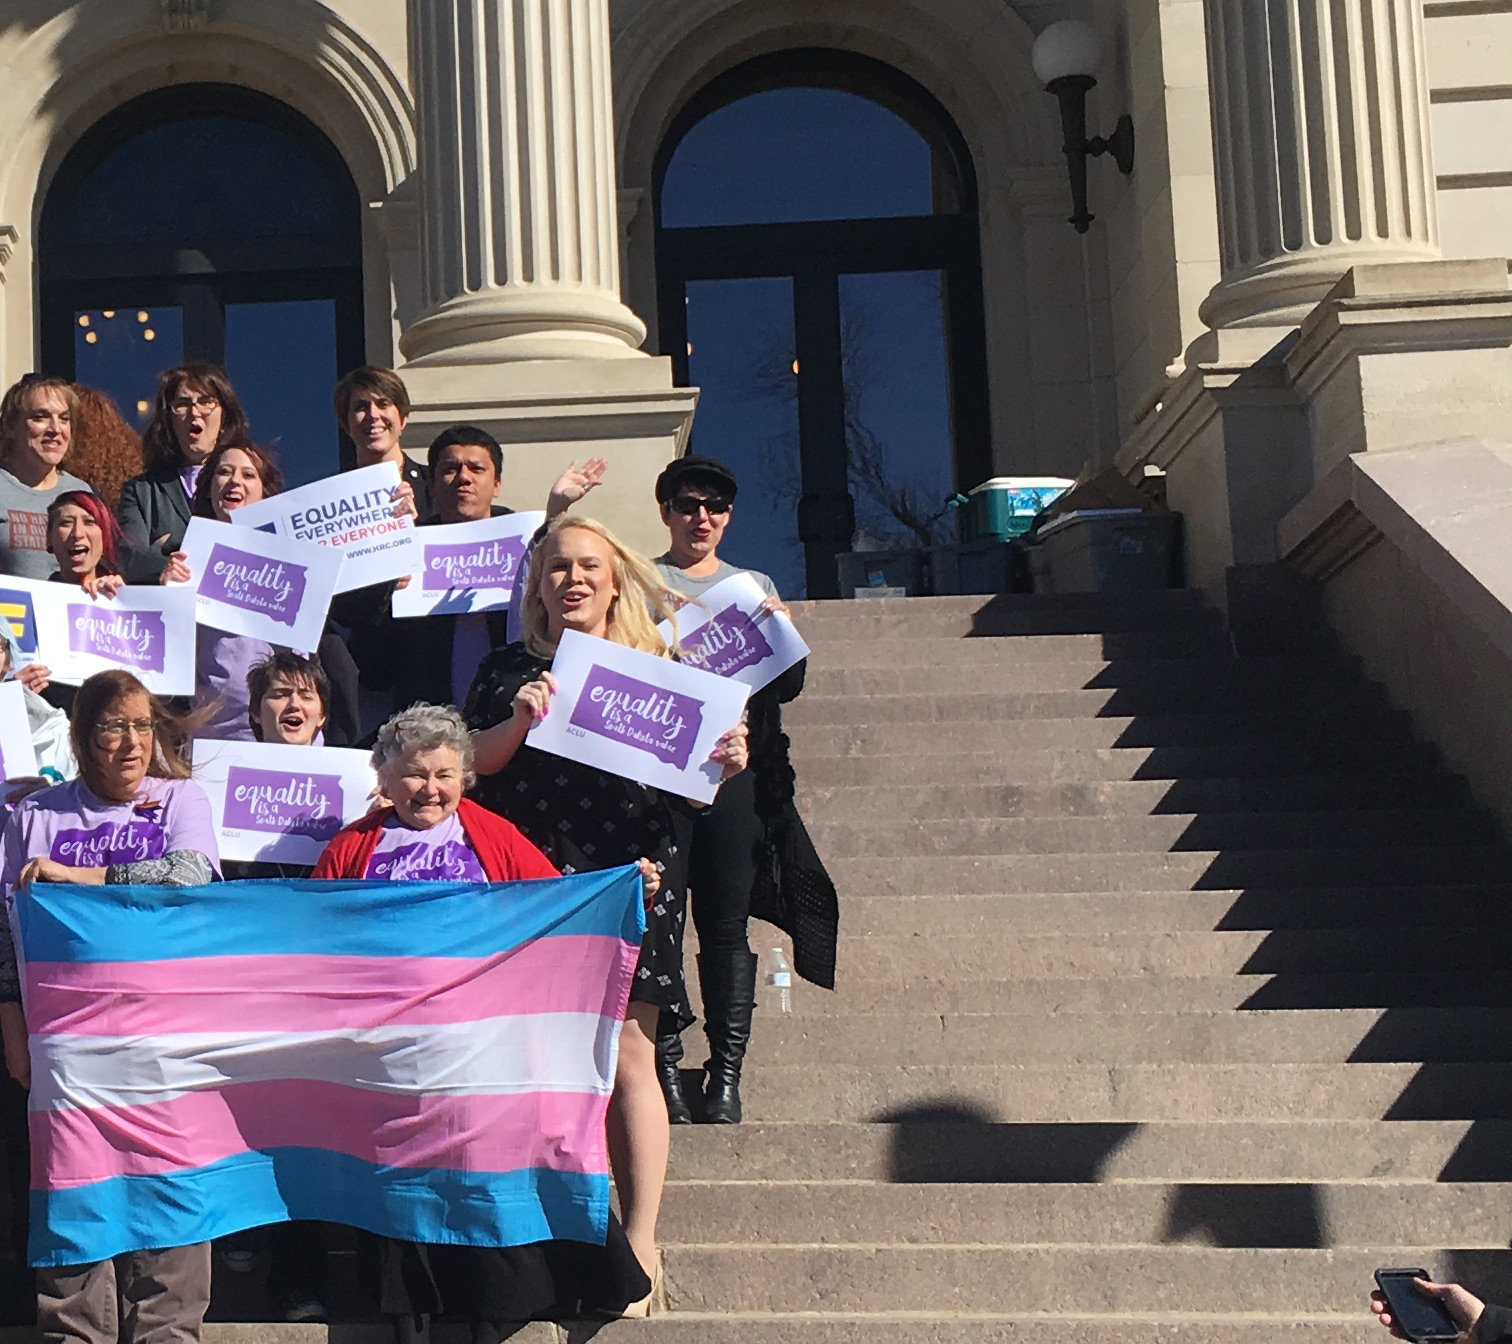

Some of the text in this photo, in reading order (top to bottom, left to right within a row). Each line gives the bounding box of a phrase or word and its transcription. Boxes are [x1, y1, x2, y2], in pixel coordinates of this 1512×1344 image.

[11, 513, 28, 523] NO
[290, 485, 397, 531] EQUALITY
[13, 524, 47, 536] IN OU
[294, 507, 392, 541] EVERYWHER
[331, 518, 408, 547] EVERYONE
[346, 537, 412, 559] WWW.HRC.ORG
[430, 541, 516, 579] equality
[213, 560, 294, 602] equality
[452, 567, 472, 578] is a
[231, 576, 249, 591] is a
[75, 613, 155, 652] equality
[96, 631, 111, 645] is a
[589, 685, 687, 740] equality
[609, 706, 632, 724] is a
[566, 726, 586, 738] ACLU
[604, 720, 677, 754] South Dakota value
[234, 777, 331, 819] equality
[258, 801, 279, 815] is a
[256, 814, 276, 825] South
[221, 830, 240, 838] ACLU
[59, 825, 153, 866] equality
[82, 851, 94, 867] is
